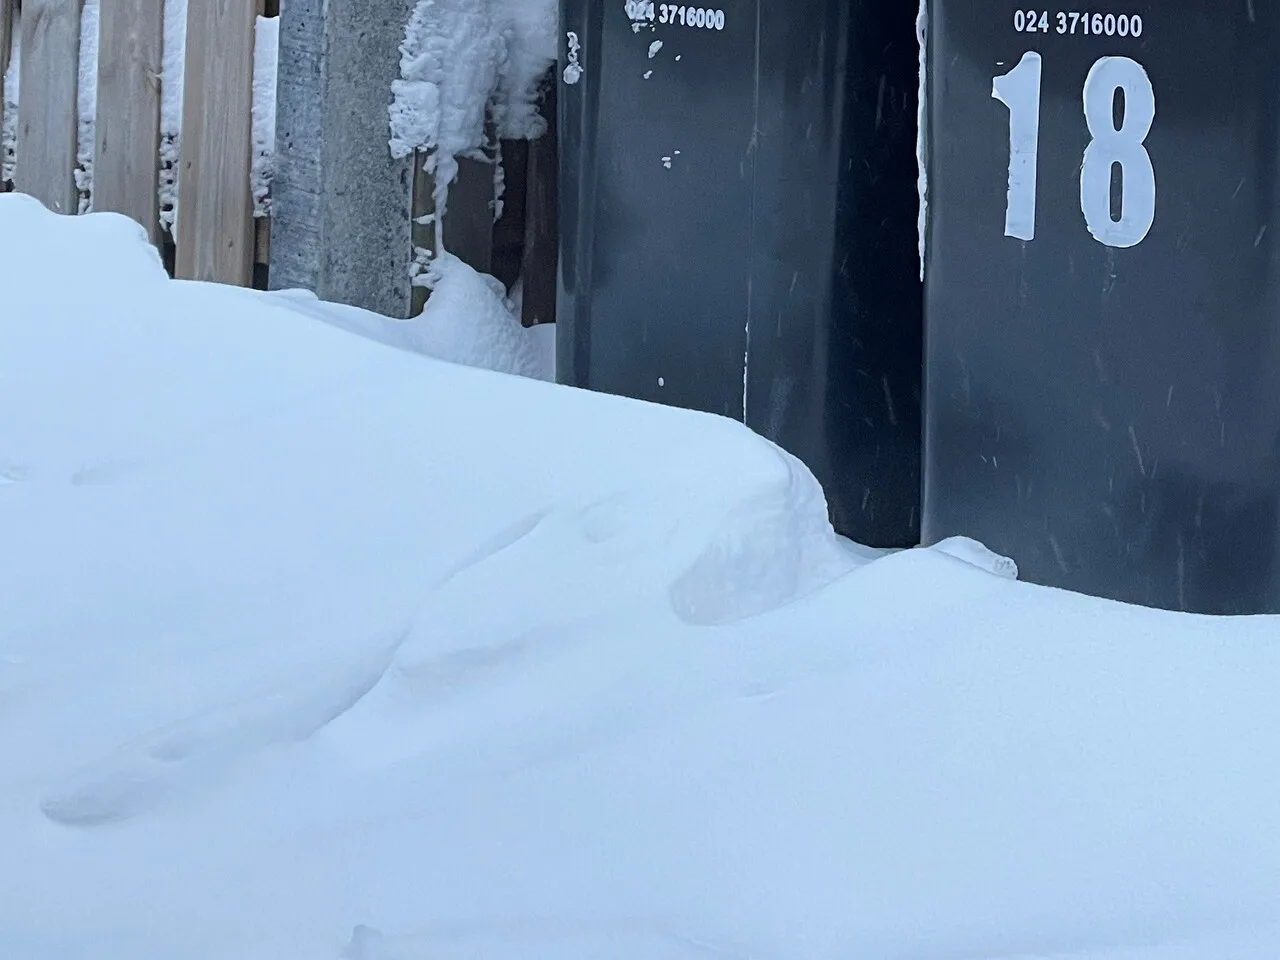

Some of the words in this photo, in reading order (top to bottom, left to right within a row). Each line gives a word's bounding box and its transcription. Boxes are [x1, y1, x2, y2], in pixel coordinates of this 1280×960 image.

[659, 3, 725, 30] 3716000
[1013, 9, 1049, 33] 024
[1056, 11, 1143, 38] 3716000
[991, 50, 1156, 248] 18
